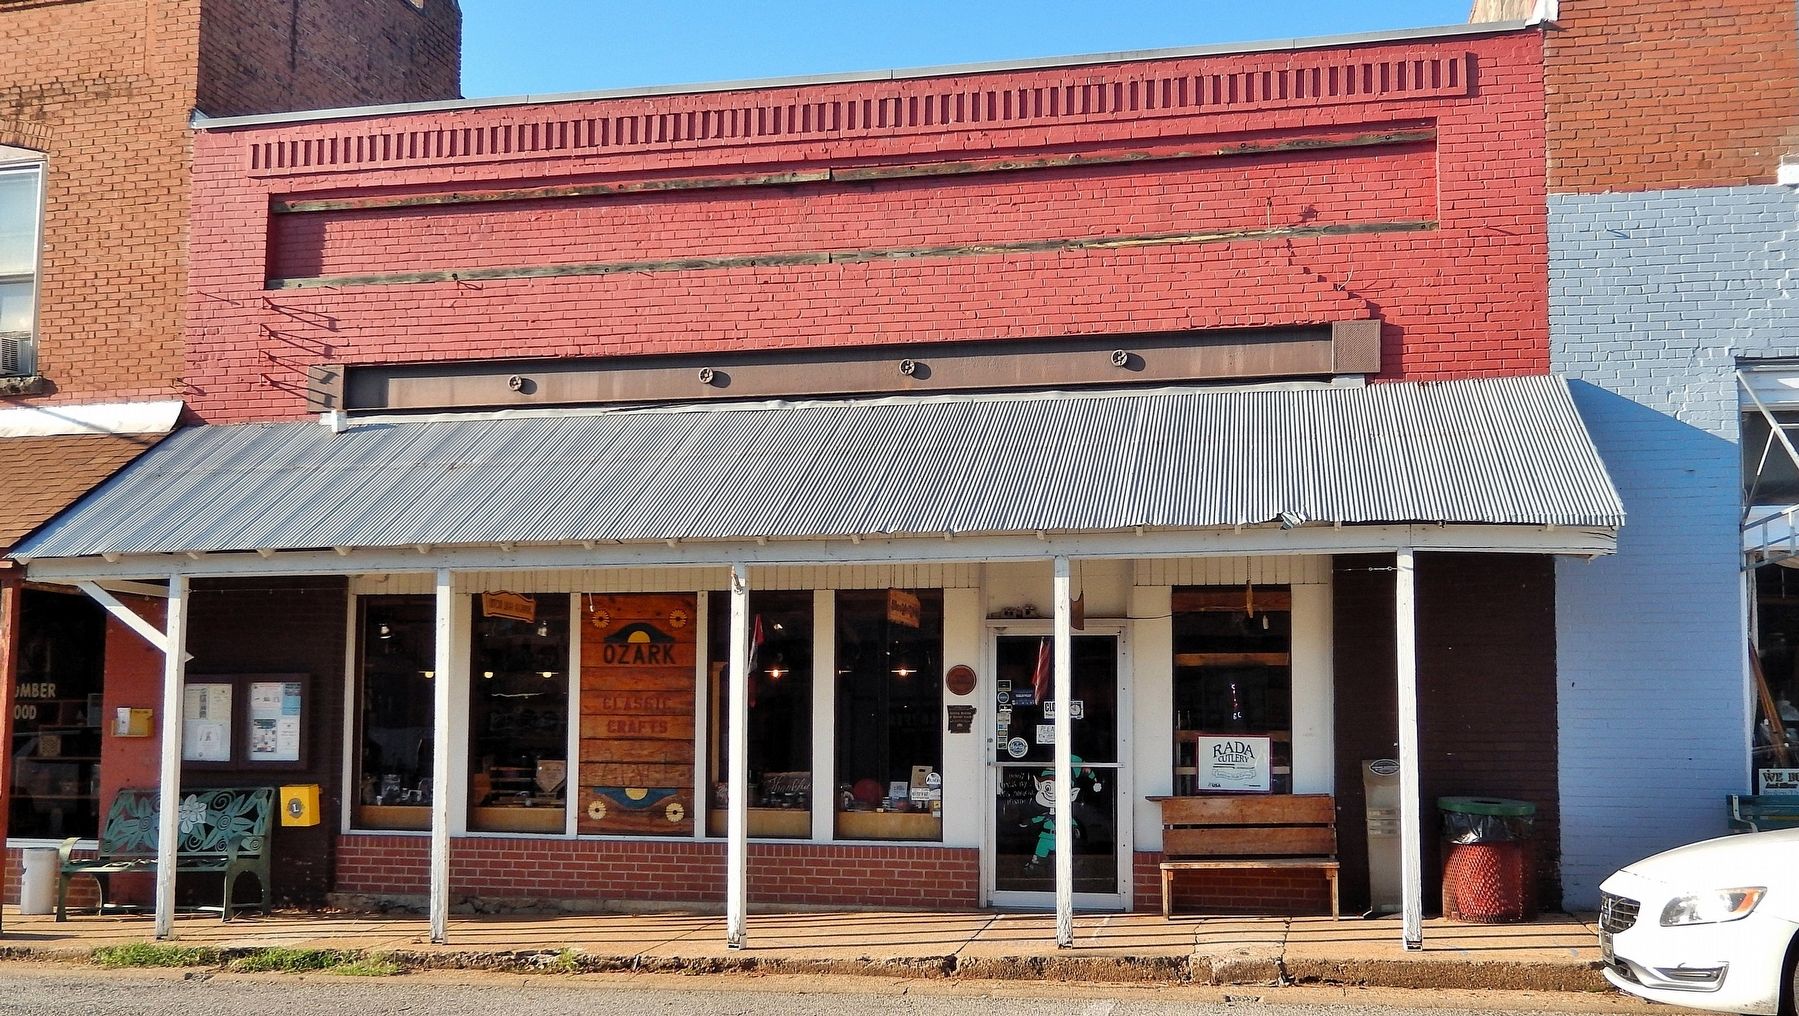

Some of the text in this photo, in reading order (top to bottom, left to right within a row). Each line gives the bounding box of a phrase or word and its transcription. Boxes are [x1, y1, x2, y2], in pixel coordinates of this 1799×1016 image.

[603, 644, 676, 665] OZARK
[602, 696, 673, 711] CLASSIC
[14, 704, 37, 720] OOD
[607, 719, 668, 734] CRAFTS
[1213, 741, 1255, 759] RADA
[1217, 753, 1249, 763] CUTLERY
[1762, 772, 1783, 782] WE
